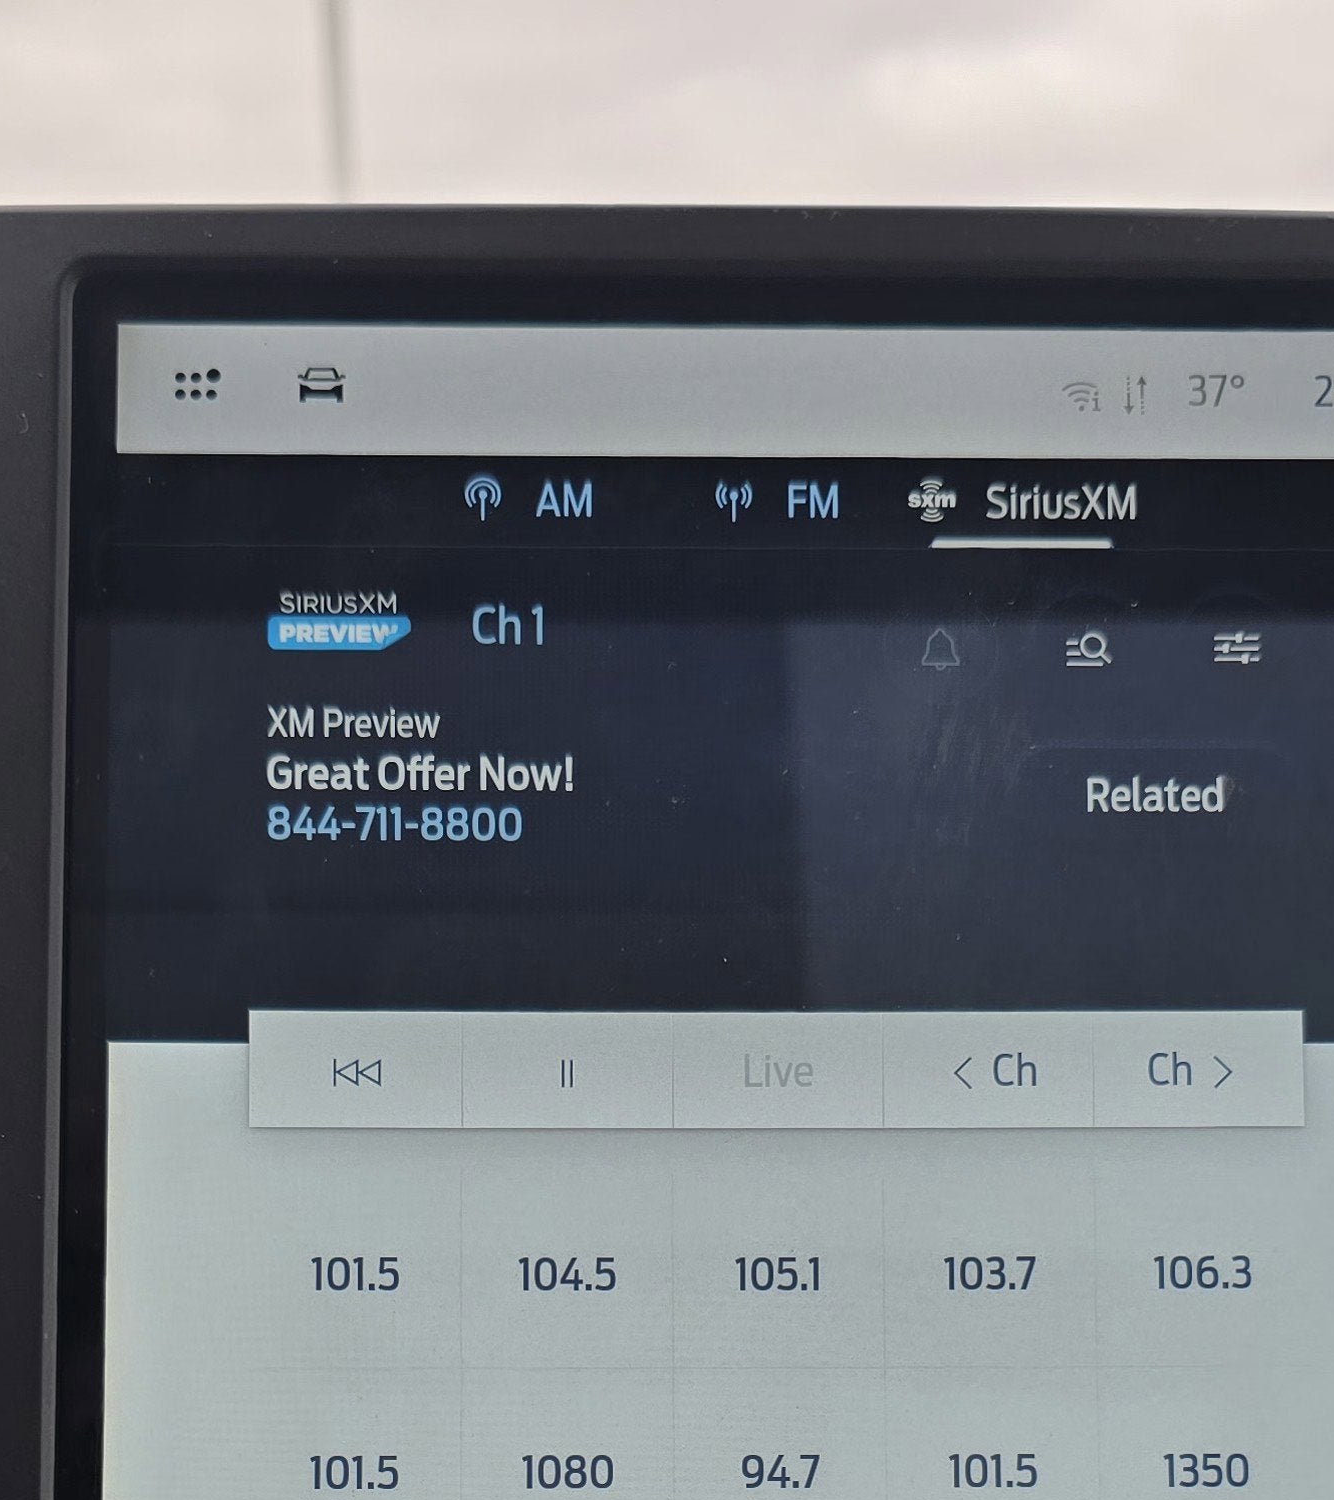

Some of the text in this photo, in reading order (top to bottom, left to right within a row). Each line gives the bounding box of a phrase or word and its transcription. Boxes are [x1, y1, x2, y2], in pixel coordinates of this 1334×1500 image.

[1188, 374, 1245, 408] 37°
[535, 480, 593, 518] AM
[787, 481, 839, 519] FM
[985, 482, 1137, 521] SiriusXM
[280, 591, 397, 615] SIRIUSXM
[278, 622, 399, 644] PREVIEW
[472, 602, 544, 646] Ch 1
[267, 705, 441, 739] XM Preview
[266, 752, 574, 792] Great Offer Now!
[1086, 775, 1226, 813] Related
[267, 805, 523, 842] 844-711-8800
[743, 1052, 814, 1090] Live
[993, 1051, 1037, 1087] Ch
[1148, 1051, 1192, 1086] Ch
[310, 1256, 400, 1292] 101.5
[518, 1256, 617, 1292] 104.5
[734, 1256, 820, 1292] 105.1
[943, 1255, 1037, 1291] 103.7
[1153, 1255, 1252, 1290] 106.3
[309, 1455, 399, 1490] 101.5
[521, 1454, 614, 1490] 1080
[741, 1454, 821, 1489] 94.7
[948, 1453, 1038, 1489] 101.5
[1163, 1453, 1249, 1488] 1350
